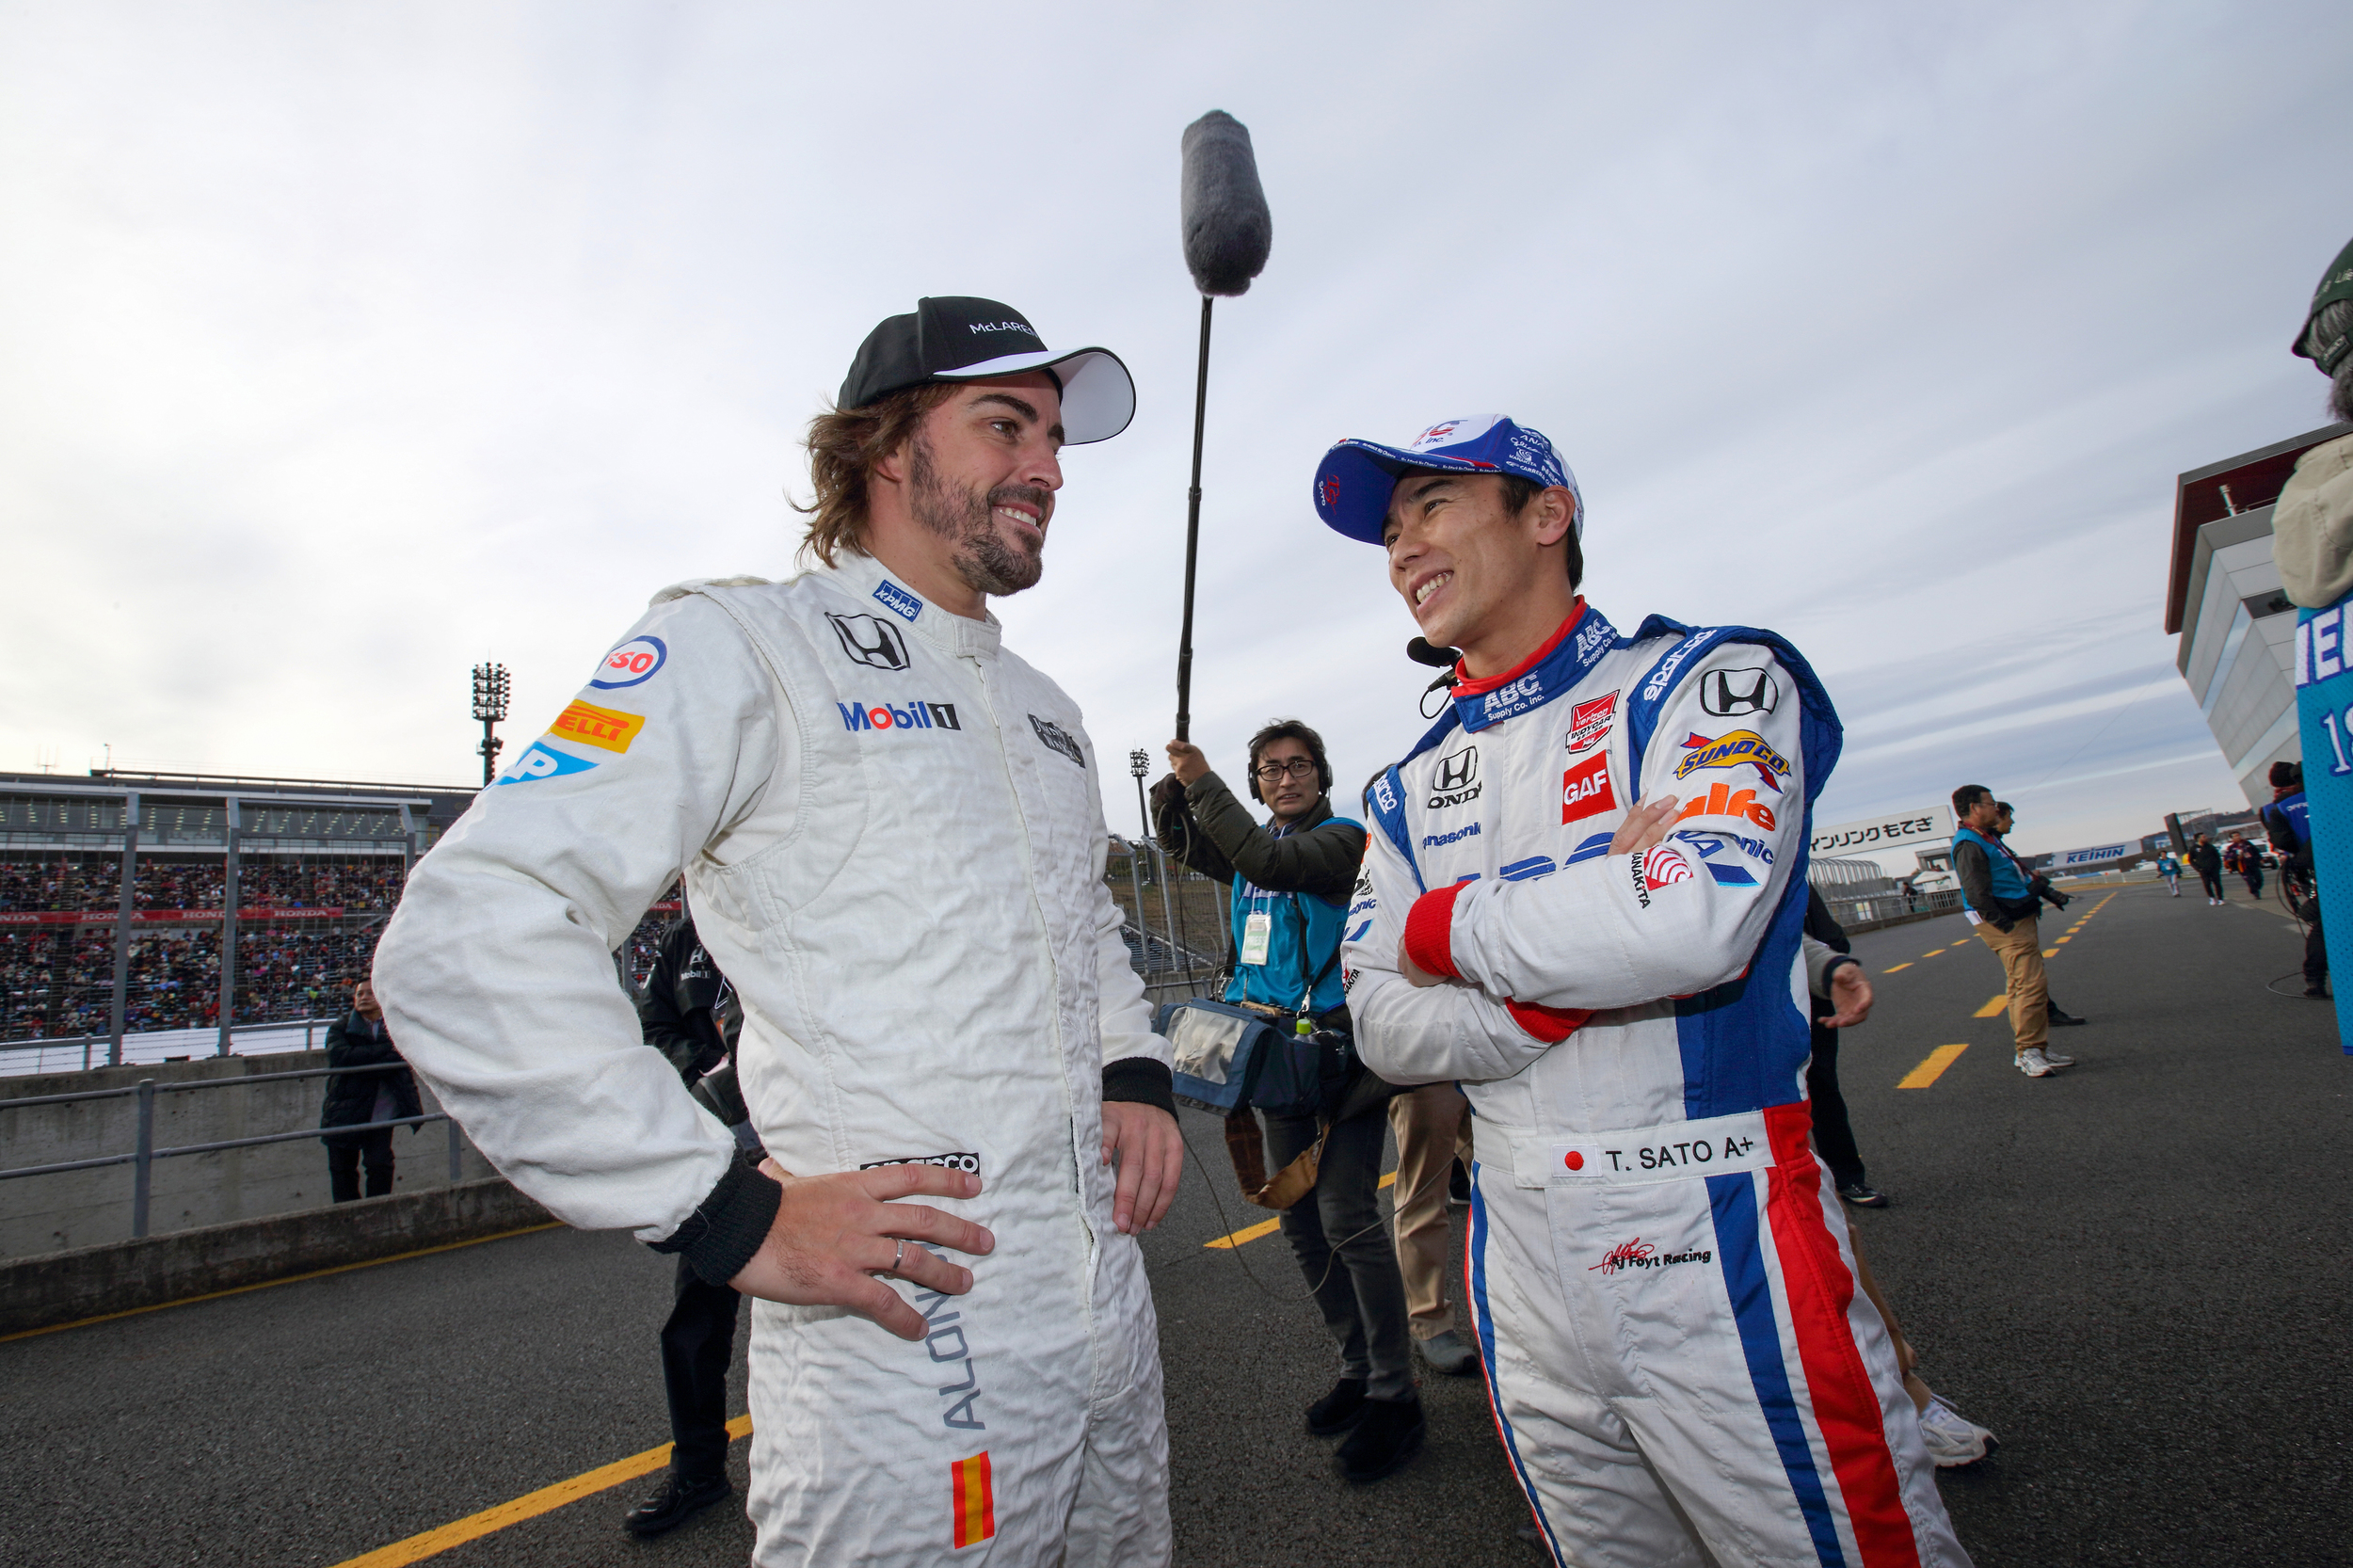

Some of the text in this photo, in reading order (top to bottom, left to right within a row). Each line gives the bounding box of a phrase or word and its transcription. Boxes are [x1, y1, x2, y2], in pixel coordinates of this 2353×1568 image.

[875, 589, 916, 617] KPMG
[1576, 617, 1610, 663] ABC
[1582, 645, 1605, 667] Supply
[1483, 669, 1539, 714] ABC
[836, 701, 933, 731] Mobil
[1487, 695, 1545, 721] Supply Co. inc.
[554, 712, 624, 742] ELLI
[1570, 714, 1612, 739] INDYCAR
[1682, 740, 1786, 776] SUNOCO
[1373, 772, 1399, 815] parco
[1427, 780, 1482, 809] OND
[1563, 768, 1608, 806] GAF
[1810, 816, 1934, 852] インリンクもてぎ
[2066, 845, 2126, 864] KEIHIN
[0, 914, 40, 922] NDA
[81, 912, 145, 921] HONA
[182, 910, 240, 920] HOND
[273, 909, 328, 918] HONDA
[680, 969, 702, 982] Mobil
[1606, 1136, 1753, 1172] T. SATO A+
[1628, 1254, 1660, 1270] Foyt
[1663, 1247, 1712, 1267] Racing
